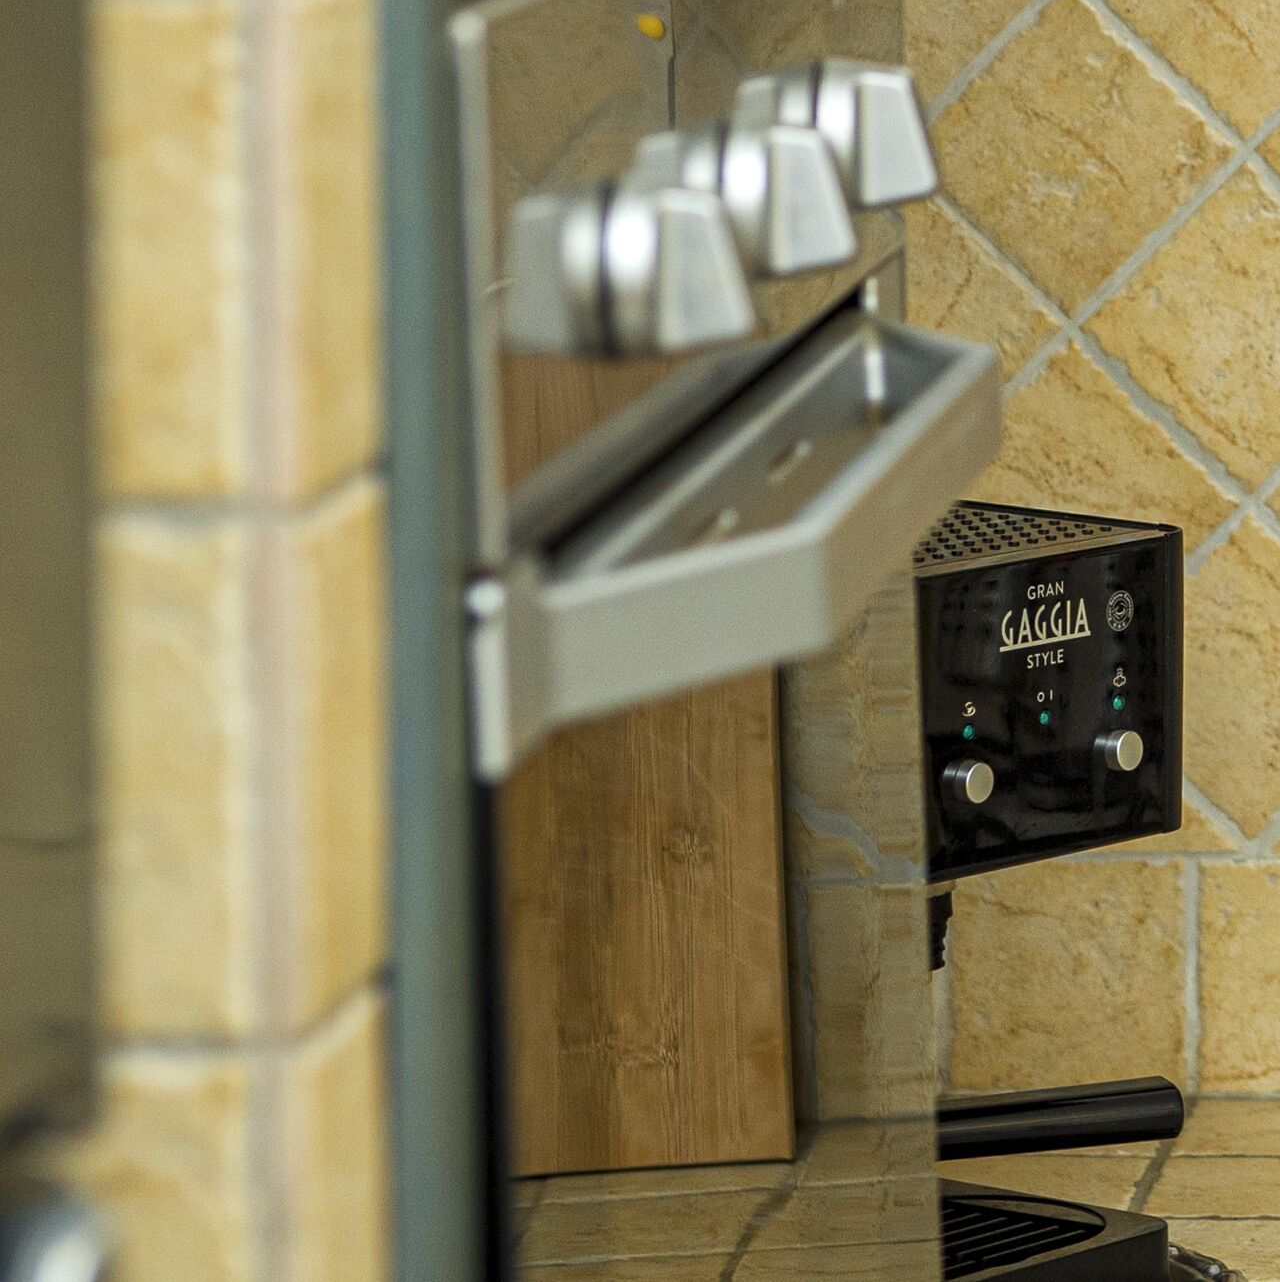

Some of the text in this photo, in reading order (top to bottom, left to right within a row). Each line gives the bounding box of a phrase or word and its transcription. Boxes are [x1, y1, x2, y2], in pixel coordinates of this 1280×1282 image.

[1027, 580, 1065, 600] GRAN
[1001, 597, 1090, 647] GAGGIA
[1026, 648, 1065, 669] STYLE
